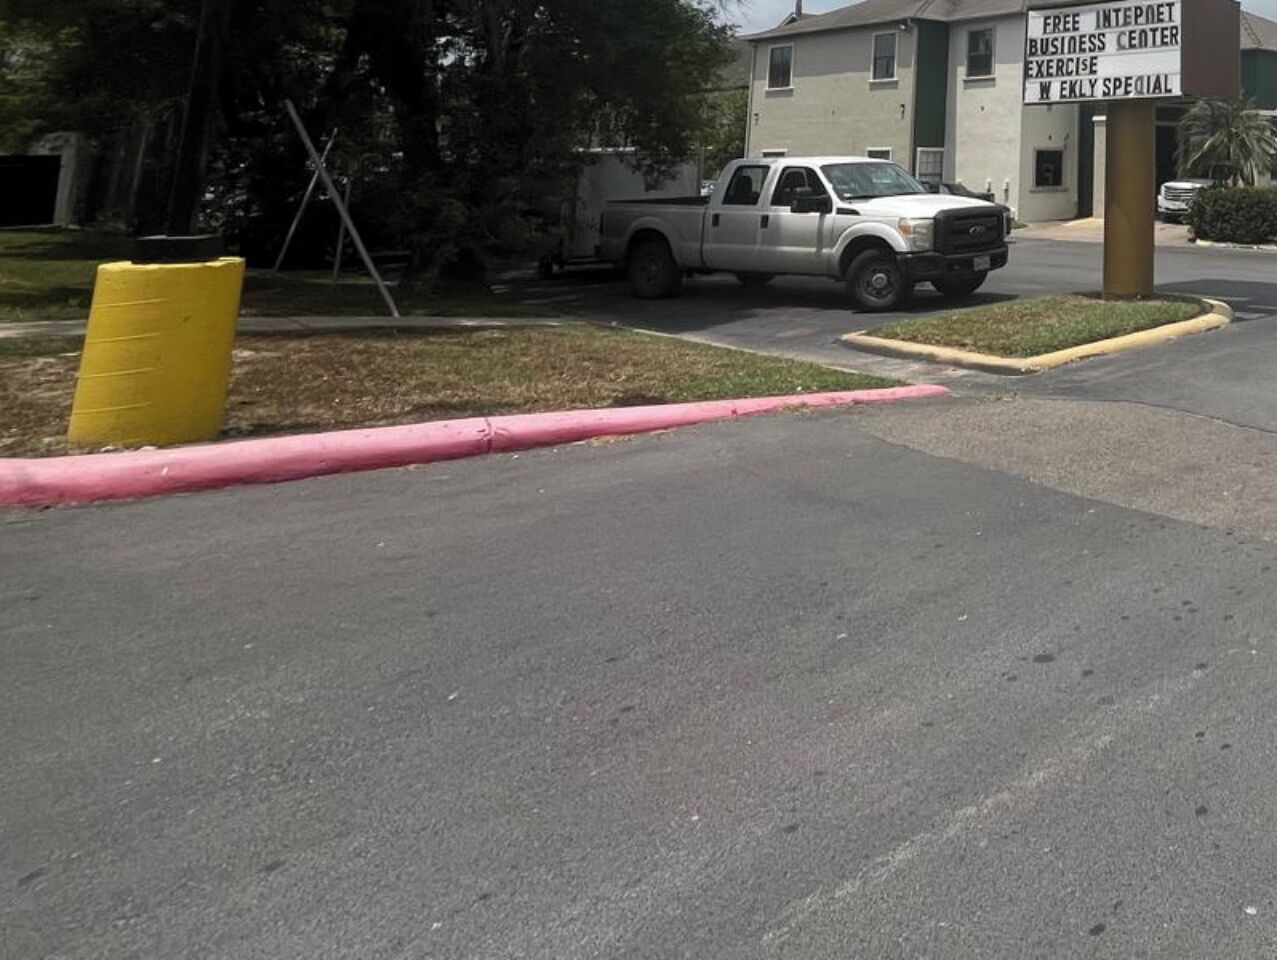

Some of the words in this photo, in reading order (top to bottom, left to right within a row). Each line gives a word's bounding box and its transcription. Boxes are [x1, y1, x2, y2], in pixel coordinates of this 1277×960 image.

[1043, 13, 1081, 35] FREE
[1028, 32, 1106, 56] BUSINESS
[1116, 25, 1179, 52] CENTER
[1026, 56, 1098, 78] EXERCISE
